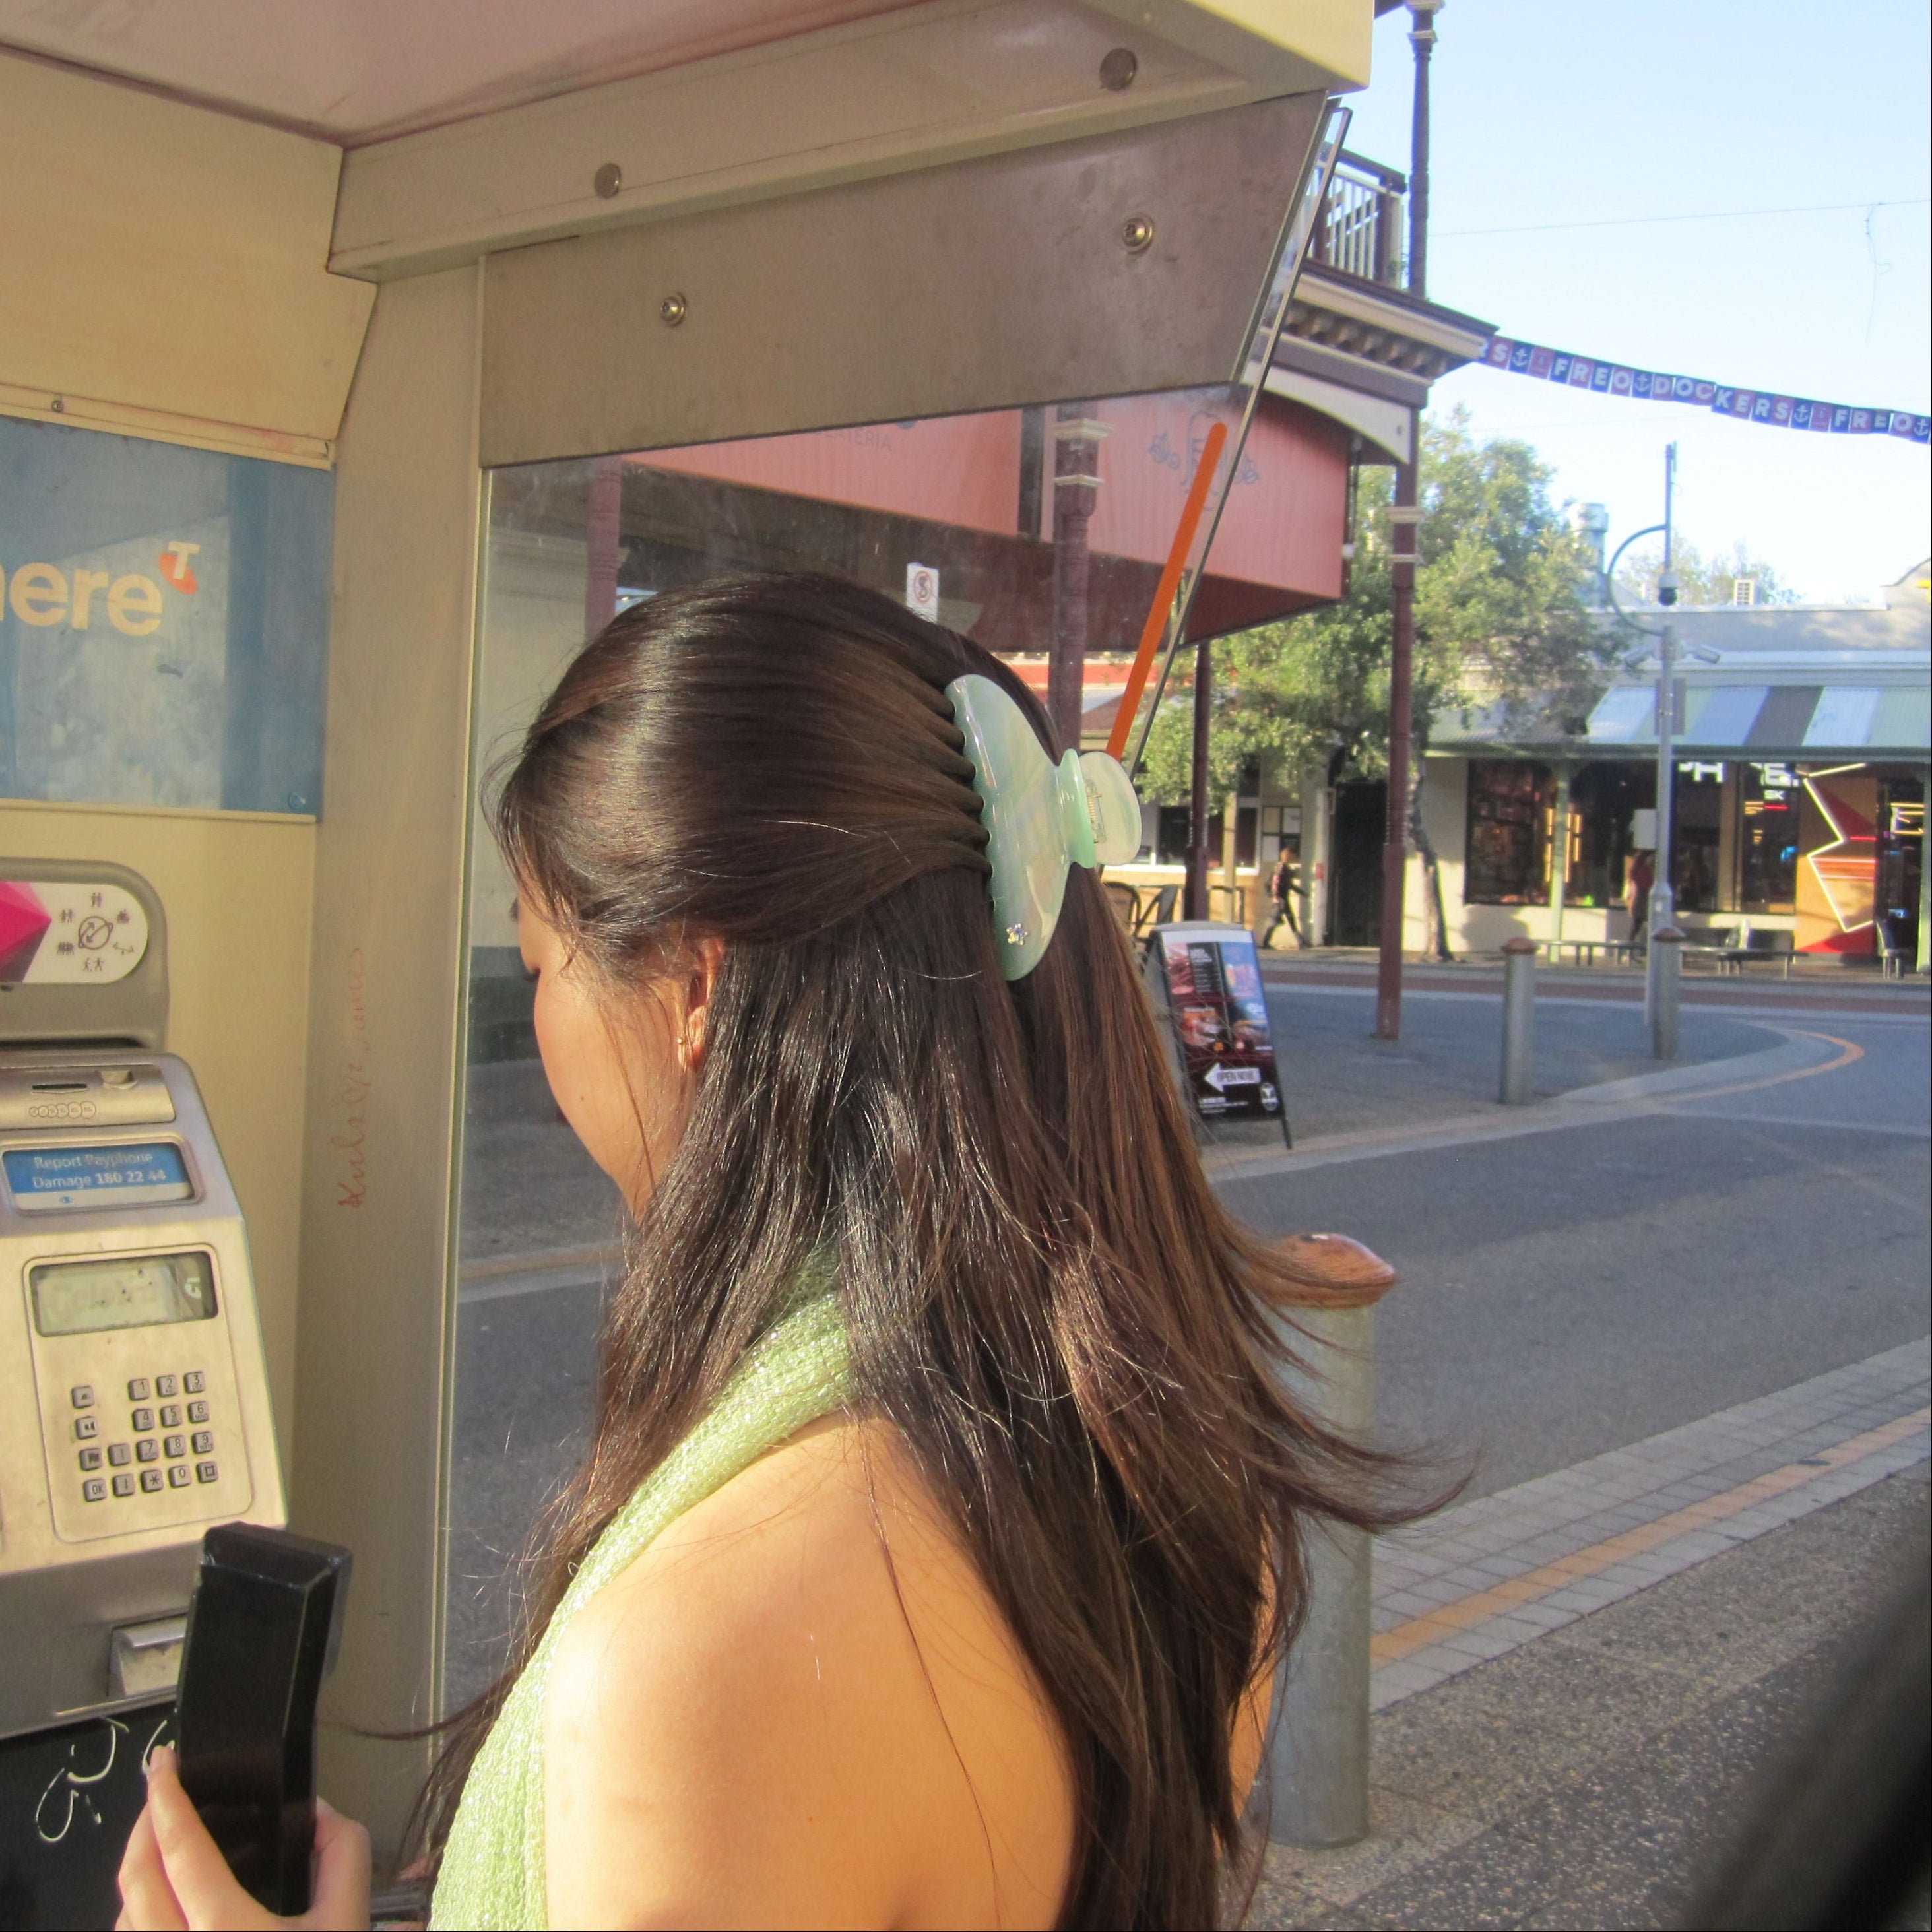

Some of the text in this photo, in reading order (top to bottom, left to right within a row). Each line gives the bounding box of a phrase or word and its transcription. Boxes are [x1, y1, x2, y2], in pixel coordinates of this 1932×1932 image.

[1554, 358, 1632, 389] FREO
[1654, 378, 1789, 422] DOCKERS
[1834, 408, 1913, 432] FREO
[0, 560, 164, 637] ere
[33, 1152, 154, 1171] Report Payphone
[32, 1175, 92, 1190] Damage
[95, 1172, 122, 1185] 180
[126, 1171, 144, 1182] 22
[166, 1377, 173, 1387] 2
[194, 1374, 200, 1384] 3
[143, 1411, 149, 1421] 4
[197, 1404, 204, 1413] 6
[174, 1438, 181, 1448] 8
[202, 1434, 209, 1444] 9
[91, 1484, 104, 1495] OK
